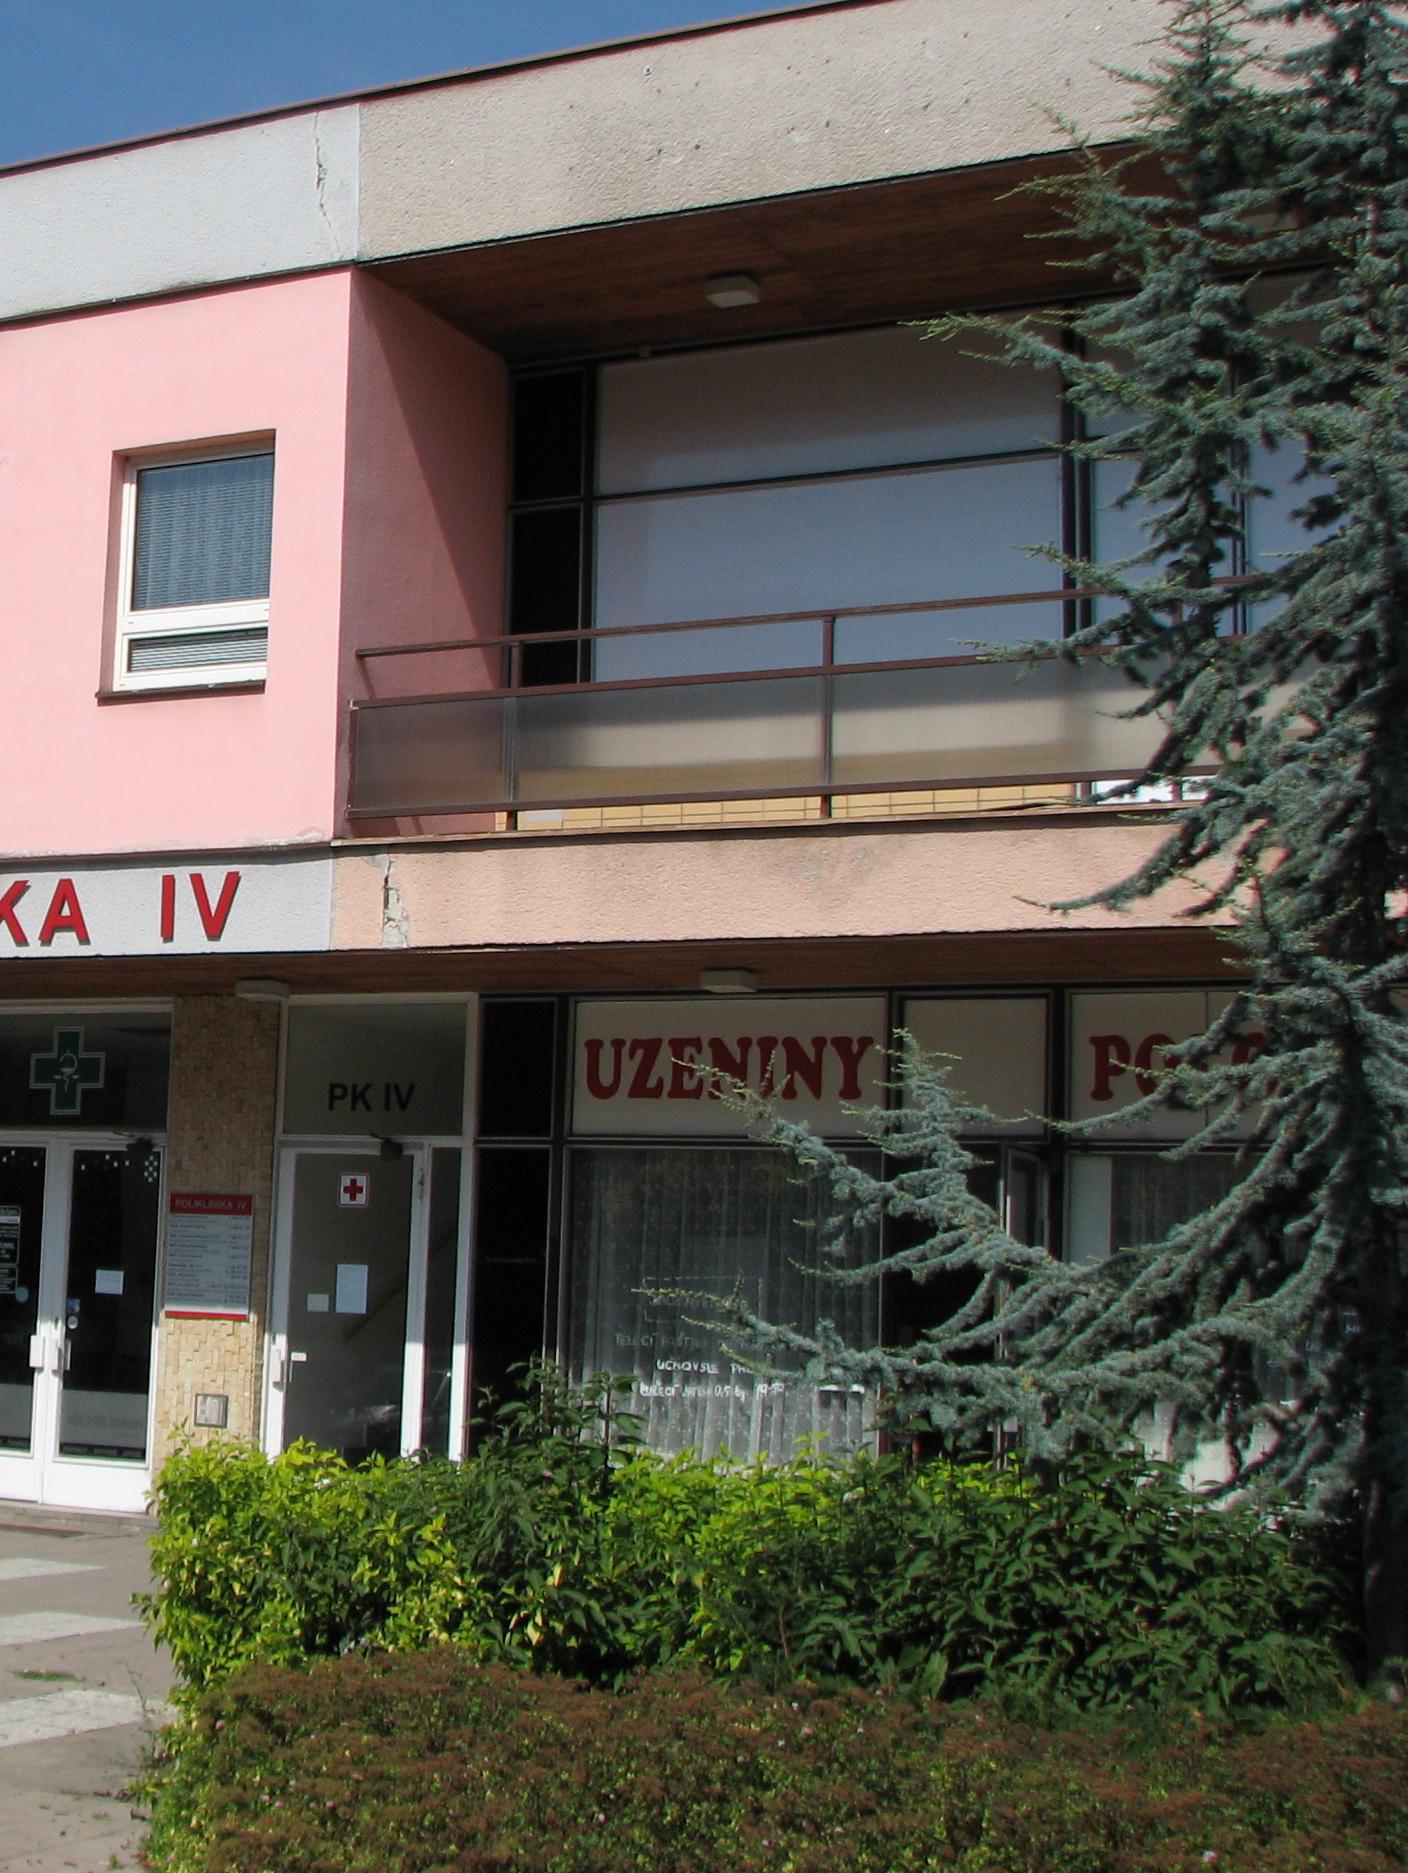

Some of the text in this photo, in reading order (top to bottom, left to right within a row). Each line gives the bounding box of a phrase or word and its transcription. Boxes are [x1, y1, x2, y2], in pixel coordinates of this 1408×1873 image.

[159, 871, 241, 943] IV
[584, 1035, 874, 1100] UZENINY
[328, 1082, 416, 1112] PK IV
[175, 1199, 233, 1210] POLIKLINIKA
